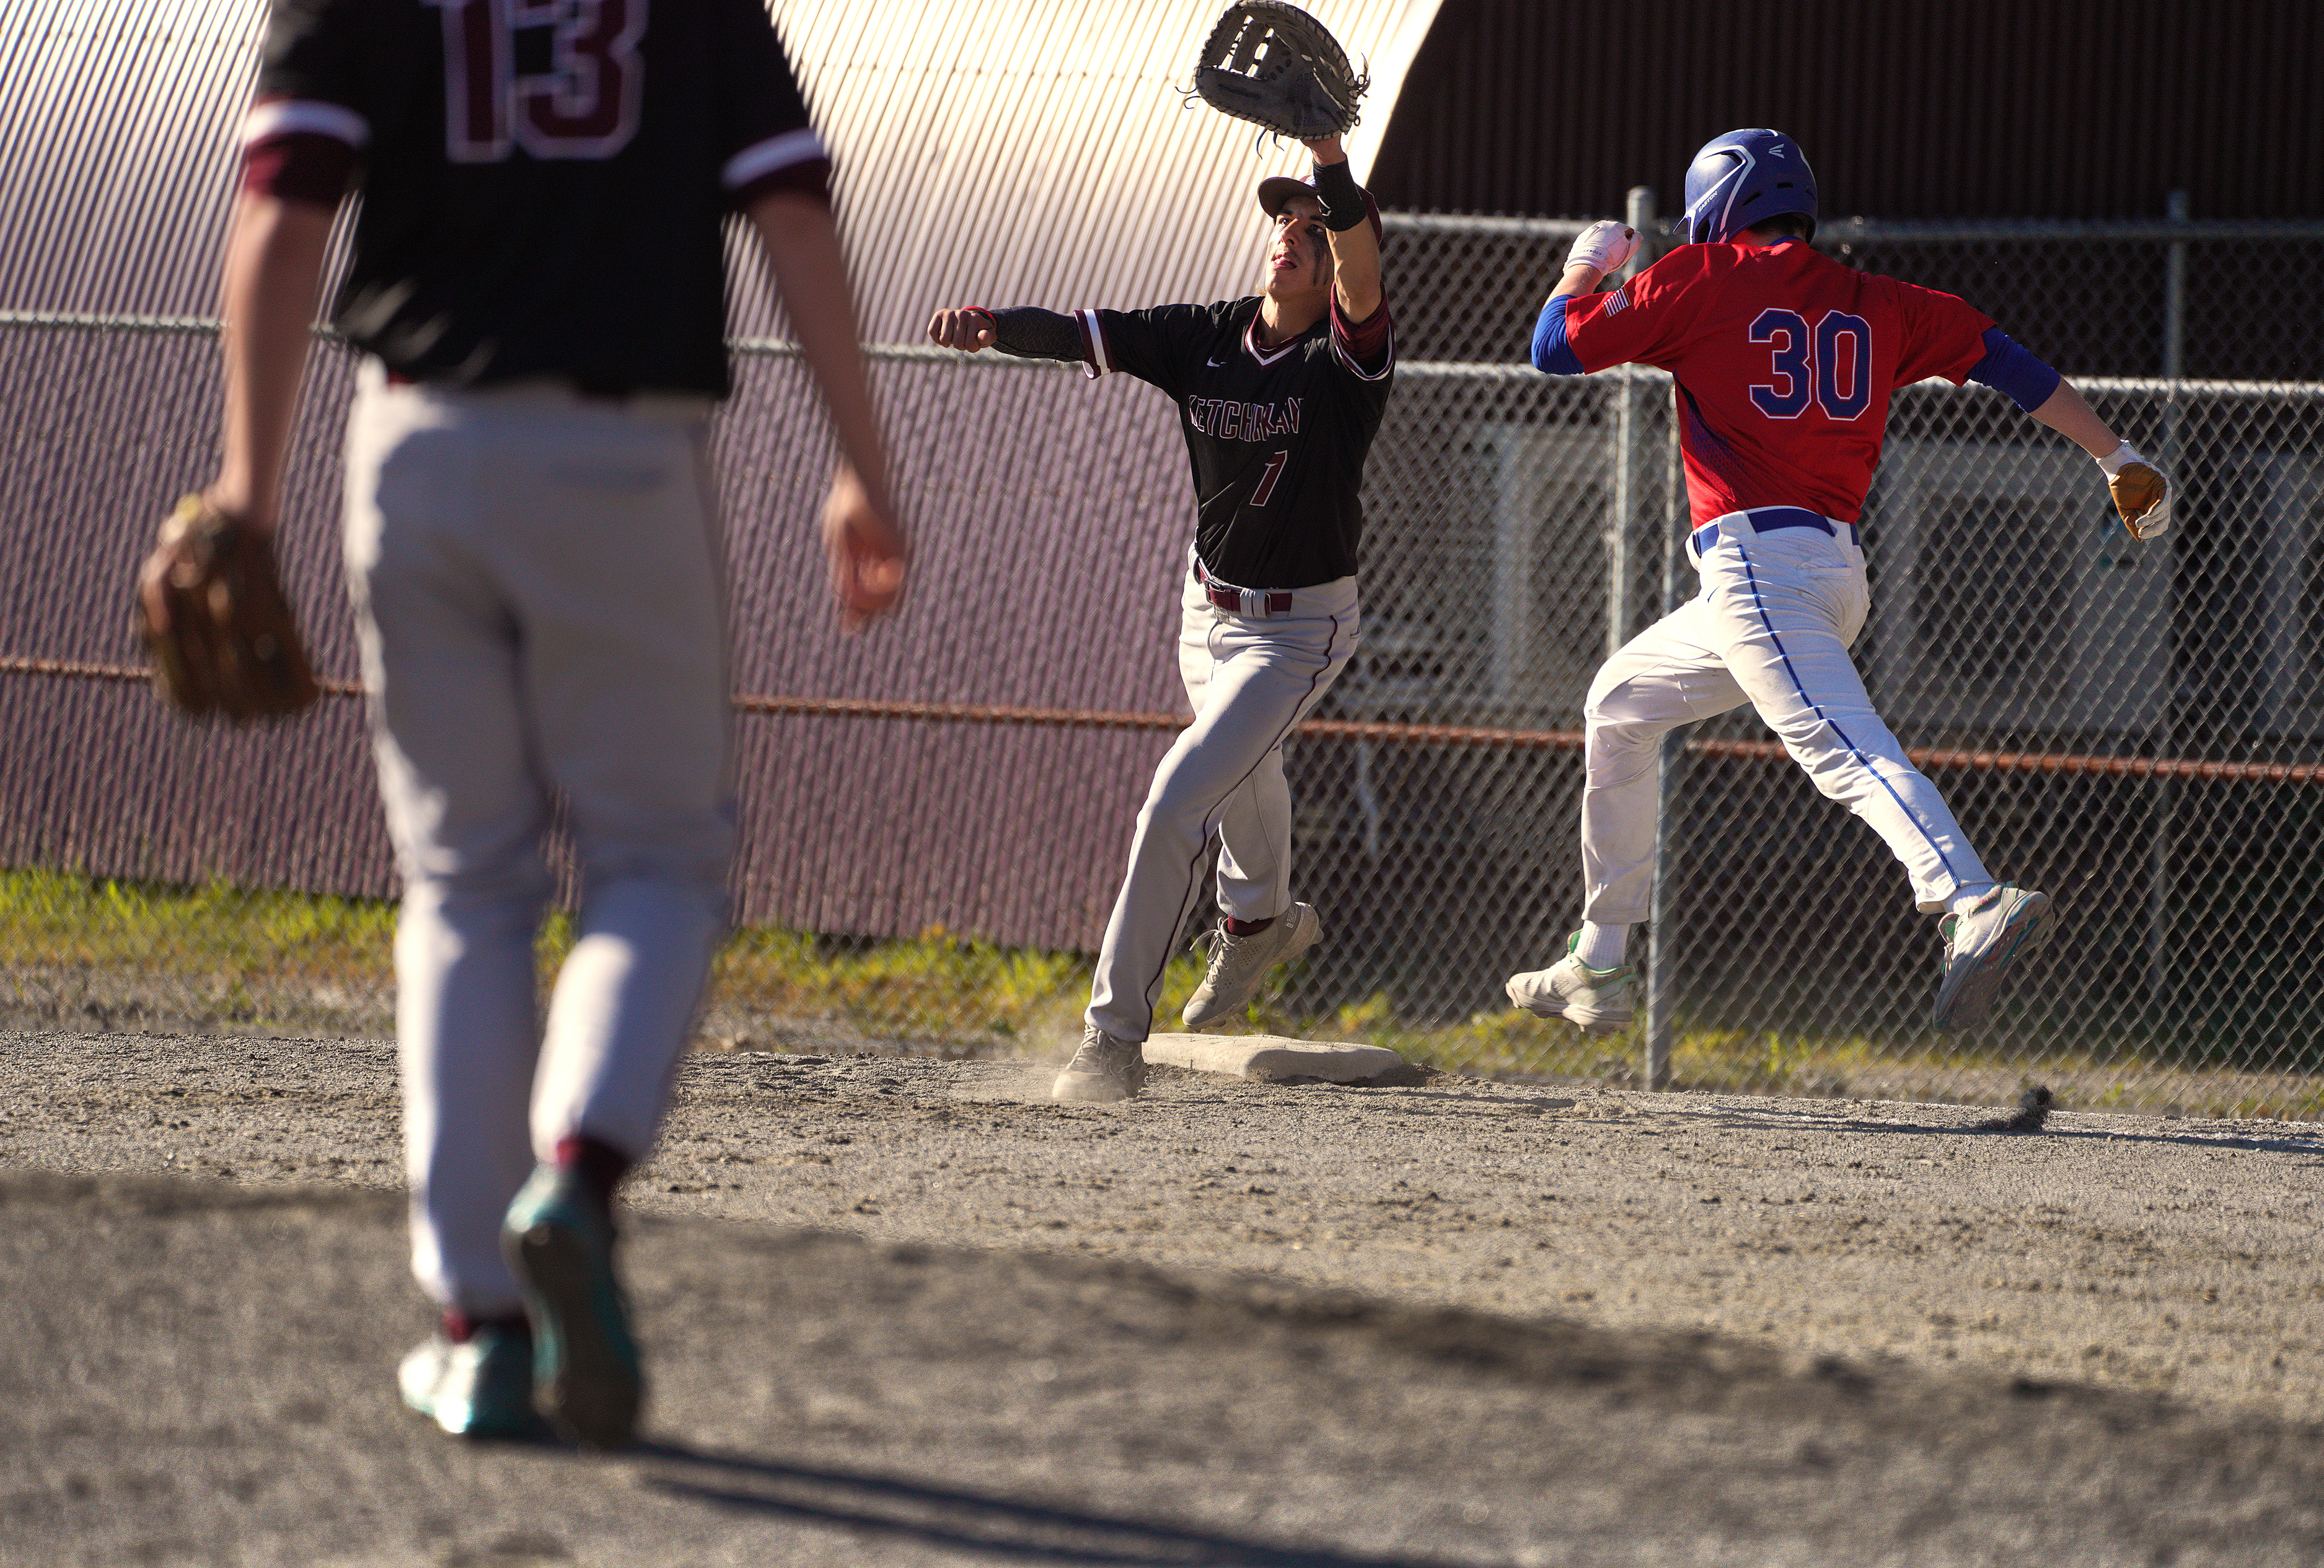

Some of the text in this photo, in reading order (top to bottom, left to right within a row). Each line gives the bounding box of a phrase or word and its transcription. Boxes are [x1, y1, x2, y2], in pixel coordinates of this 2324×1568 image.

[420, 0, 649, 164] 13
[1698, 190, 1718, 213] EASTON
[1748, 307, 1872, 421] 30
